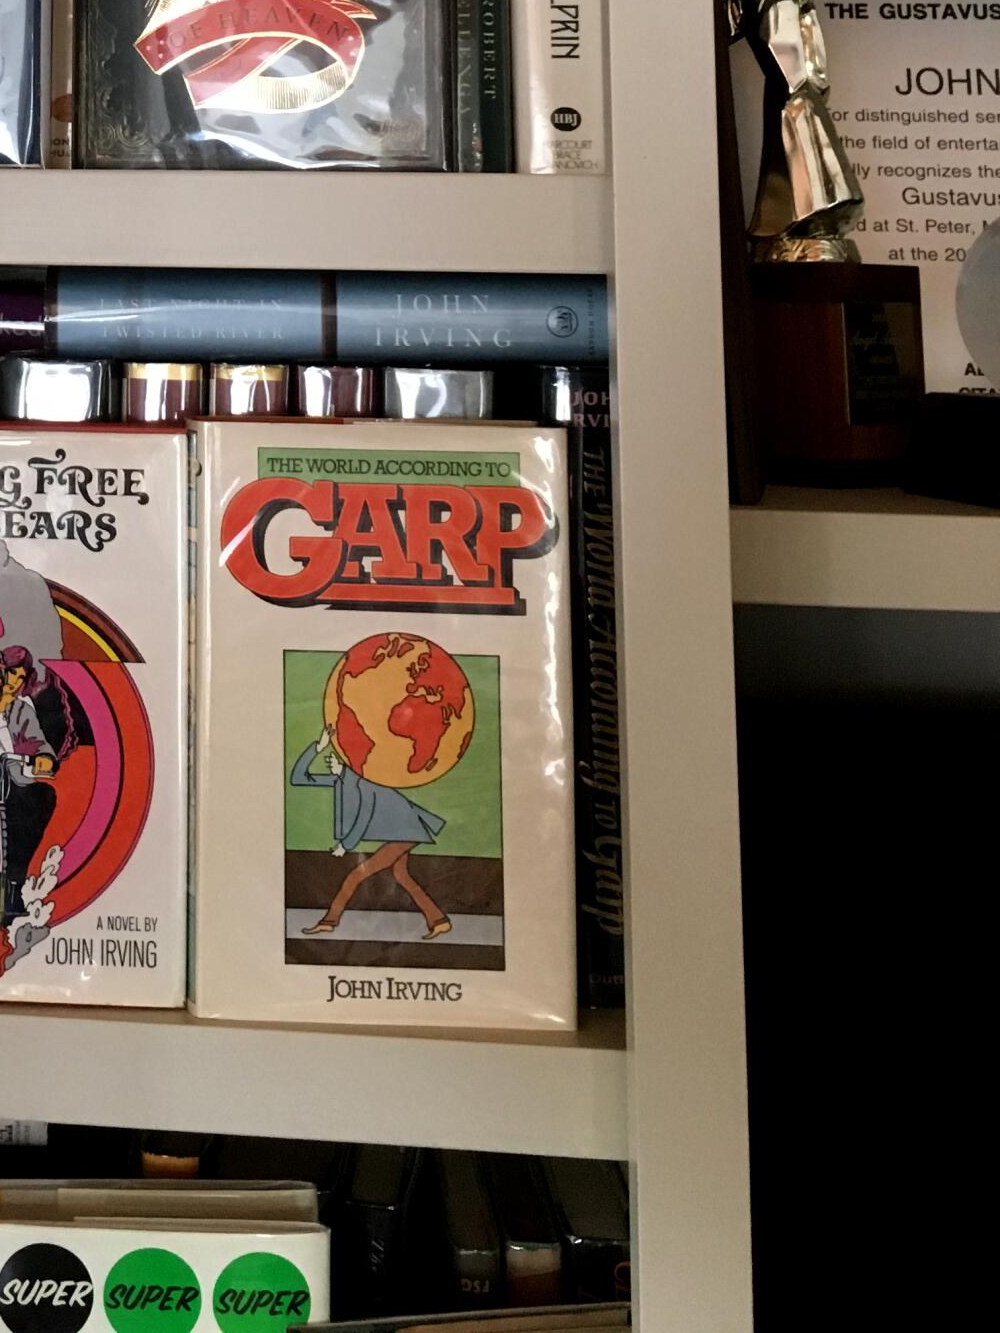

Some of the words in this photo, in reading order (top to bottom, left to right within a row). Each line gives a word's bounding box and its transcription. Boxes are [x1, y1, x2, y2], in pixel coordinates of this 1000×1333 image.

[825, 3, 869, 20] THE
[879, 3, 1000, 20] GUSTAVUS
[168, 21, 204, 49] OF
[217, 5, 353, 44] HEAVEN
[895, 68, 1000, 96] JOHN
[554, 113, 578, 127] HBJ
[855, 109, 969, 126] distinguished
[873, 135, 908, 150] field
[914, 136, 930, 150] of
[877, 166, 972, 181] recognizes
[873, 219, 890, 233] at
[896, 219, 919, 233] St.
[926, 219, 976, 235] Peter,
[888, 247, 904, 262] at
[910, 247, 938, 262] the
[393, 293, 491, 317] JOHN
[102, 327, 203, 339] TWISTED
[216, 326, 285, 339] RIVER
[375, 327, 513, 348] IRVING
[27, 448, 150, 507] FREE
[267, 457, 305, 474] THE
[304, 459, 371, 476] WORLD
[374, 460, 483, 478] ACCORDING
[485, 461, 511, 478] TO
[583, 451, 607, 496] THE
[220, 477, 560, 616] GARP
[592, 801, 615, 828] TO
[96, 916, 104, 930] A
[107, 916, 142, 932] NOVEL
[144, 917, 158, 932] BY
[45, 937, 94, 965] JOHN
[100, 939, 158, 968] IRVING
[326, 975, 383, 1002] JOHN
[386, 977, 463, 1001] IRVING
[0, 1279, 94, 1307] SUPER
[105, 1284, 199, 1312] SUPER
[215, 1289, 310, 1317] SUPER
